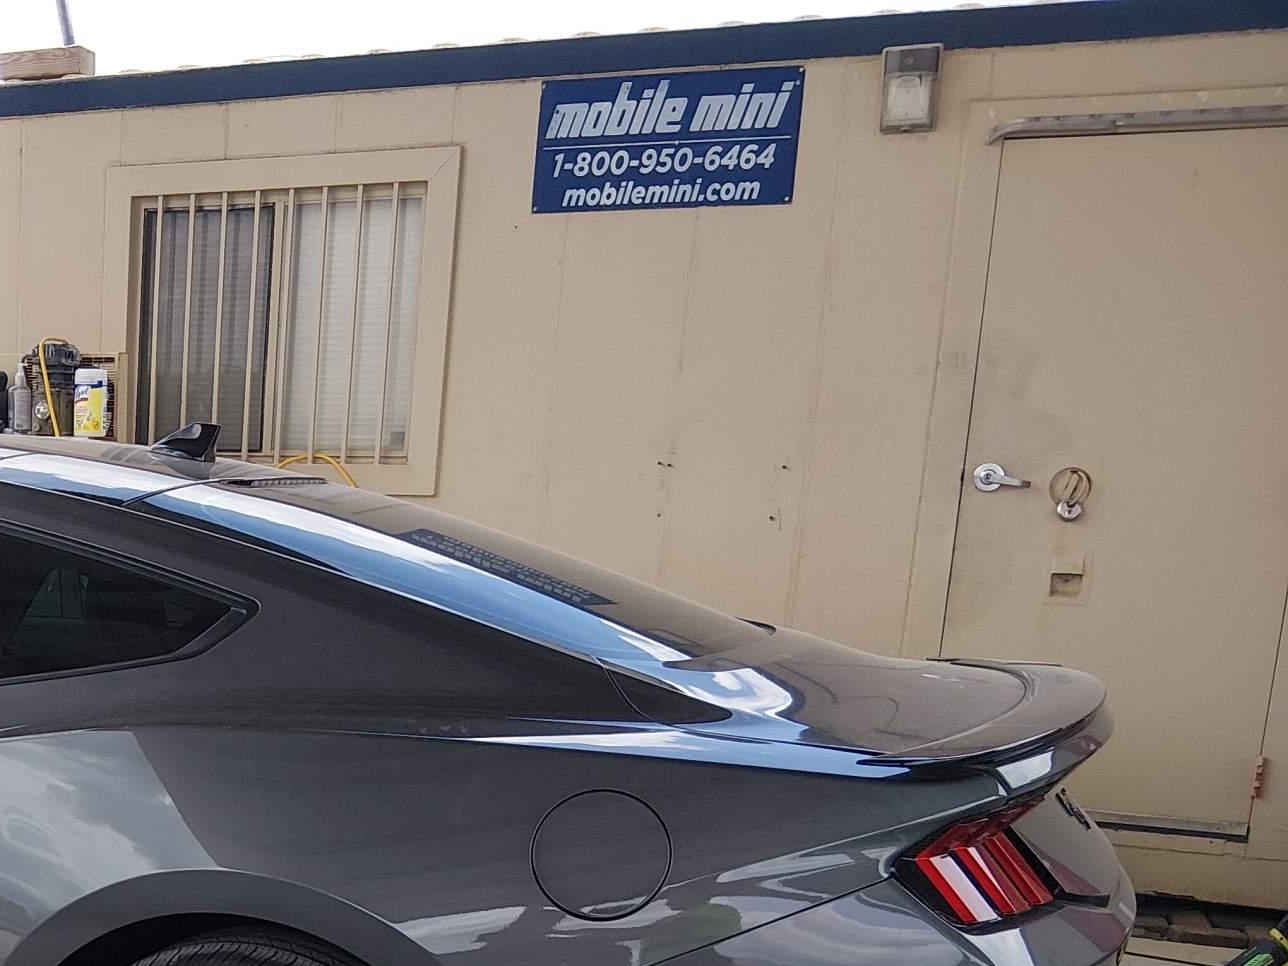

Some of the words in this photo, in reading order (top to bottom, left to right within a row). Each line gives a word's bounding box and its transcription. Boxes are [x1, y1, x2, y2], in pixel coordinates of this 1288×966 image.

[545, 80, 688, 138] mobile
[689, 82, 795, 132] mini
[553, 144, 776, 178] 1-800-950-6464
[562, 178, 760, 207] mobilemini.com
